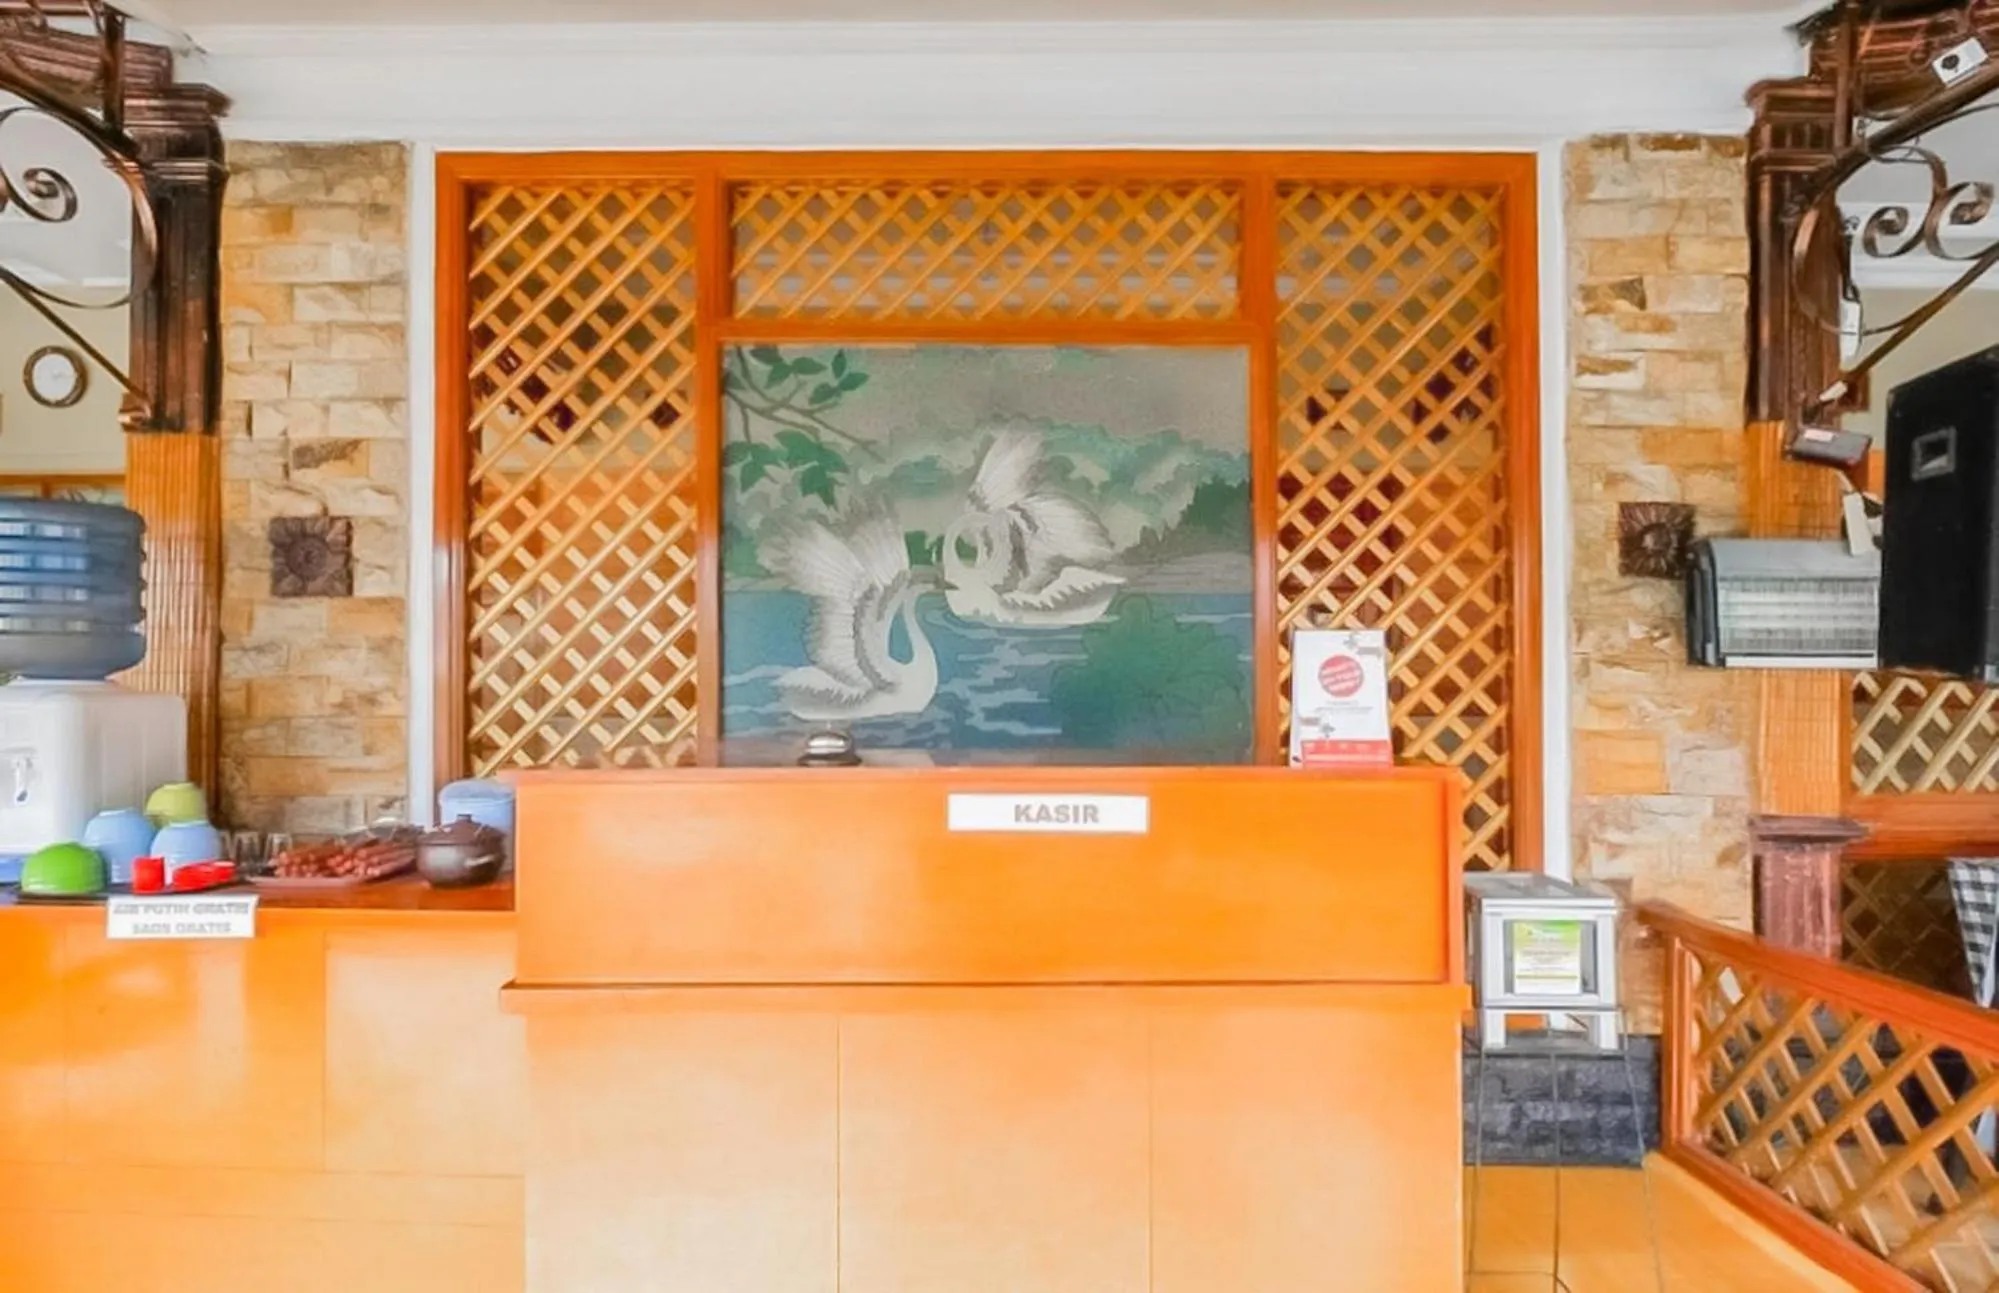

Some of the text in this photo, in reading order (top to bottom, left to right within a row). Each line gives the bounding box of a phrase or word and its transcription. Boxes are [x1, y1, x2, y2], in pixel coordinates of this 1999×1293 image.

[1014, 804, 1099, 824] KASIR
[193, 902, 249, 914] GRATIS
[175, 922, 231, 934] GRATIS
